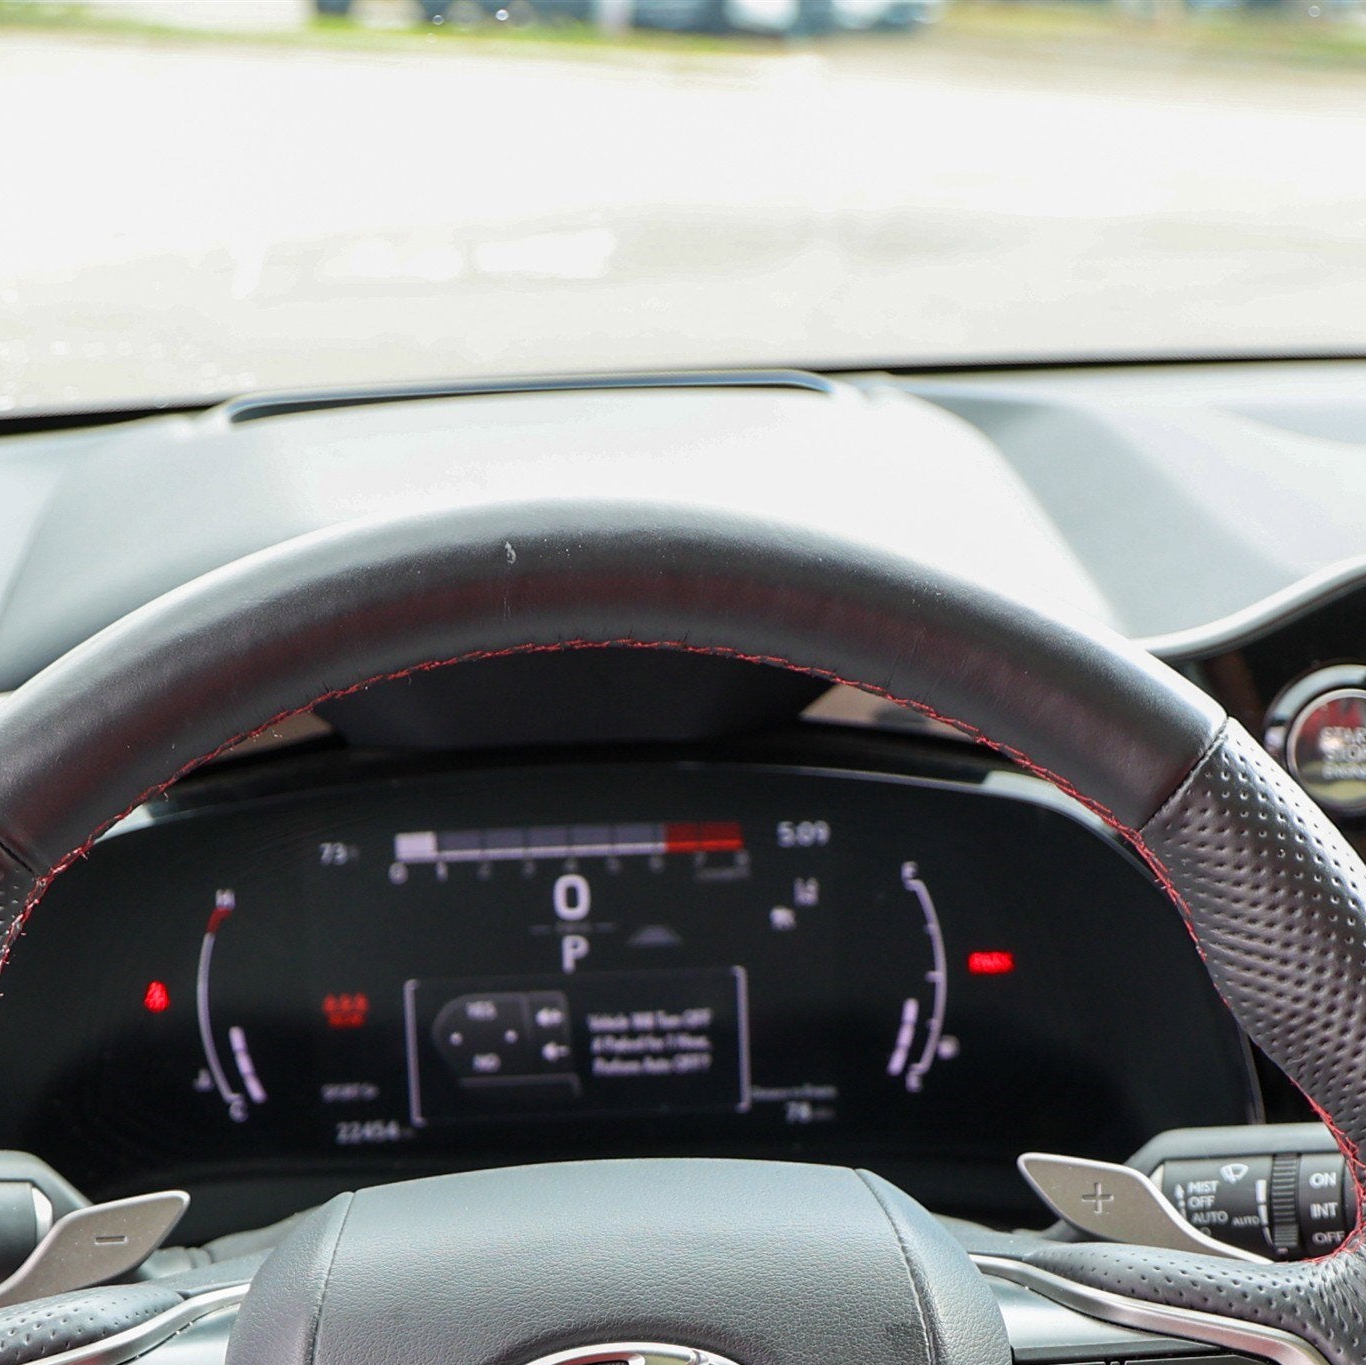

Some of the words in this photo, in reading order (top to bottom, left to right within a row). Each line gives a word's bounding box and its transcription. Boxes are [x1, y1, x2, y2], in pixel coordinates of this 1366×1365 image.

[777, 820, 831, 847] 5:09
[553, 874, 591, 921] 0
[561, 935, 590, 974] P
[1187, 1181, 1220, 1193] MIST
[1309, 1172, 1336, 1188] ON
[1187, 1195, 1214, 1208] OFF
[1191, 1211, 1229, 1223] AUTO
[1310, 1203, 1338, 1218] INT
[1233, 1216, 1260, 1226] AUTO
[1312, 1231, 1345, 1244] OFF
